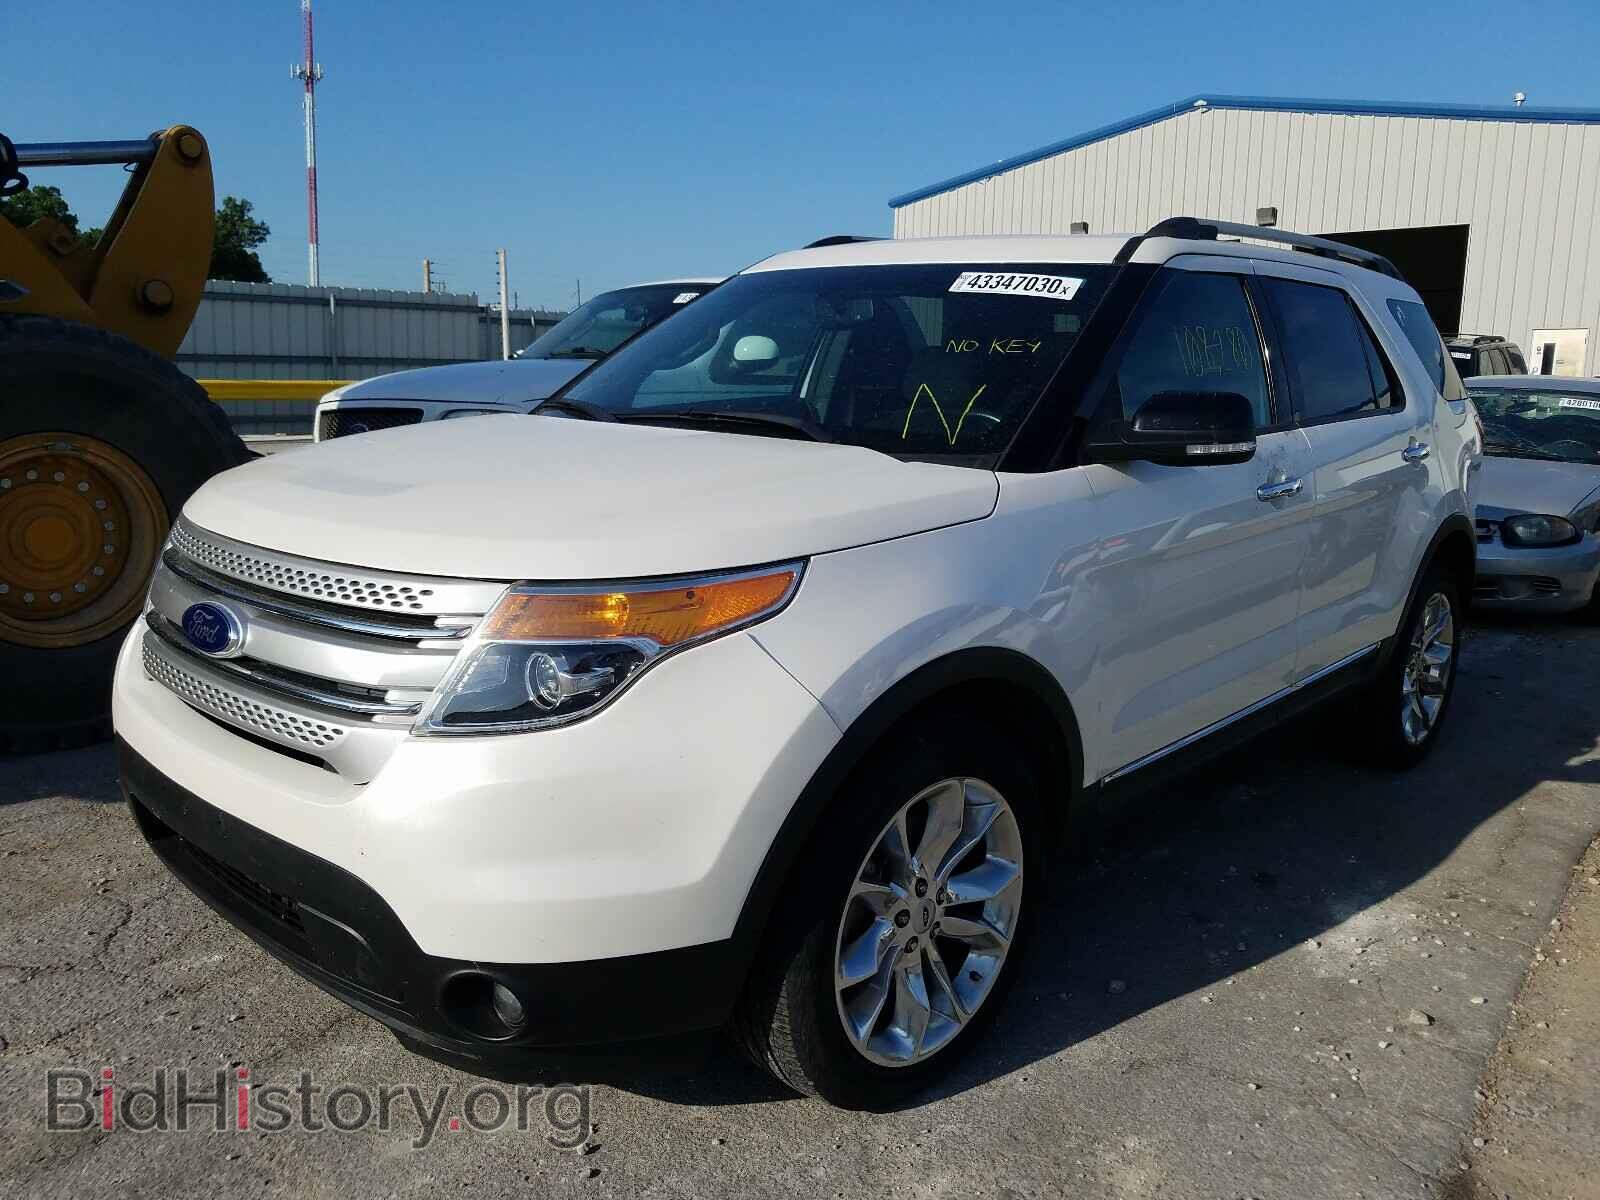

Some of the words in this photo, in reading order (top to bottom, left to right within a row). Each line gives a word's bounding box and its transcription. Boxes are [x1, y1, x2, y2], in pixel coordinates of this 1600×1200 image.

[945, 339, 979, 353] NO
[988, 337, 1042, 355] KEY
[902, 383, 987, 446] N
[1566, 399, 1600, 409] 428010
[190, 609, 220, 643] Ford
